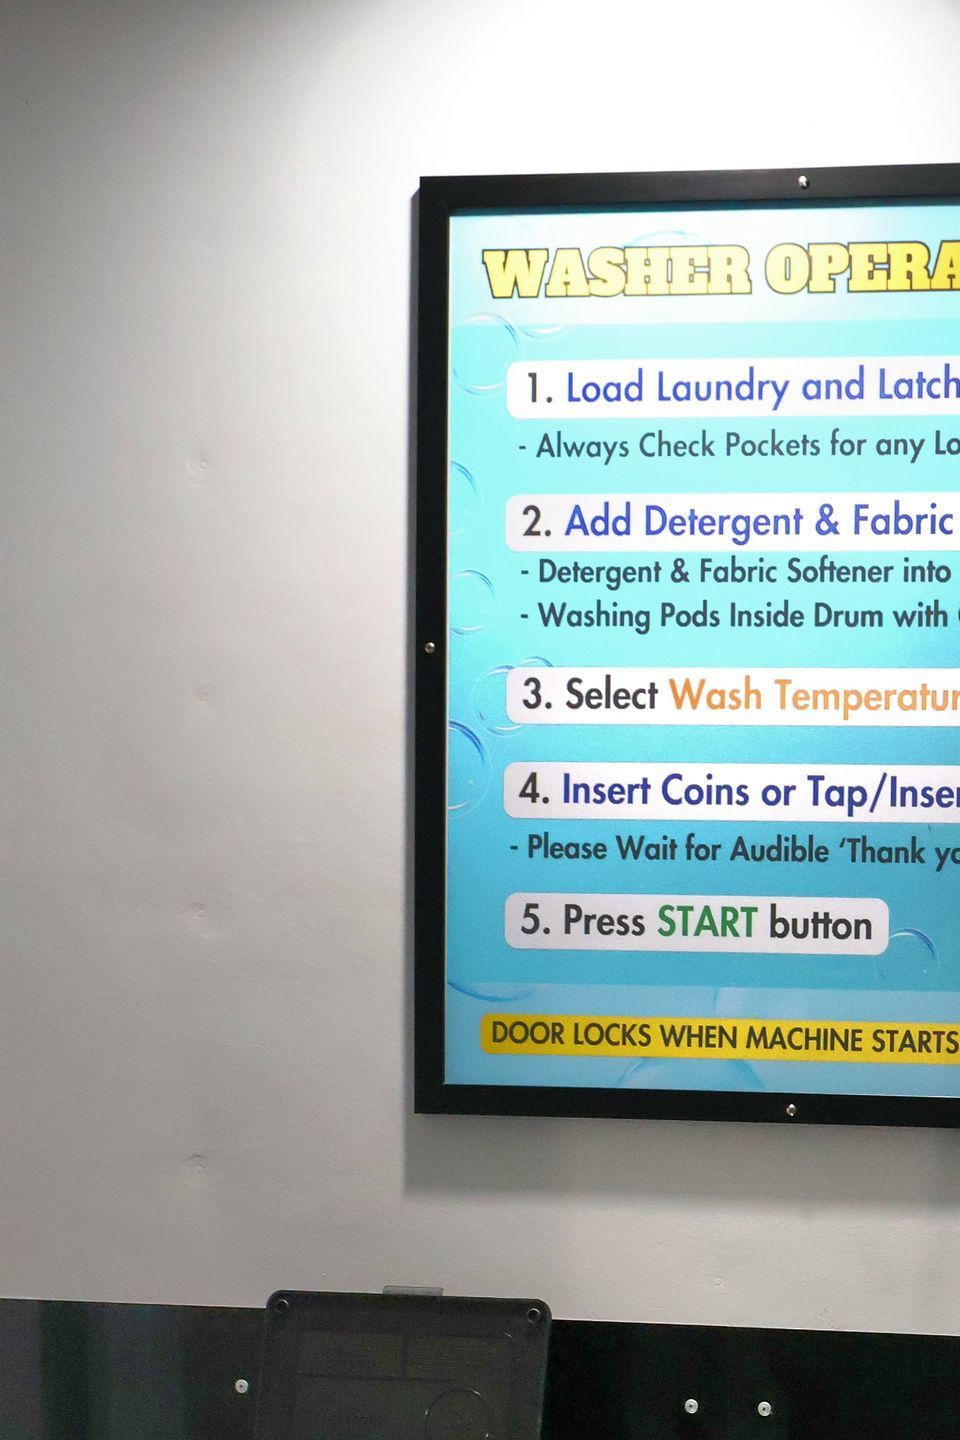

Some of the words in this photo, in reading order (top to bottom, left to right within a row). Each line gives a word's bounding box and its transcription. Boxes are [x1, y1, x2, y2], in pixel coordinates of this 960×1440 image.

[482, 244, 752, 298] WASHER
[528, 372, 552, 404] 1.
[568, 369, 642, 402] Load
[658, 368, 790, 410] Laundry
[803, 365, 864, 401] and
[536, 433, 629, 465] Always
[640, 432, 715, 459] Check
[727, 433, 820, 458] Pockets
[831, 430, 866, 457] for
[876, 437, 925, 464] any
[522, 505, 551, 537] 2.
[565, 503, 631, 537] Add
[647, 506, 803, 545] Detergent
[816, 505, 839, 536] &
[855, 503, 953, 536] Fabric
[540, 559, 662, 591] Detergent
[672, 560, 691, 584] &
[701, 557, 777, 584] Fabric
[788, 558, 891, 584] Softener
[903, 557, 952, 583] into
[538, 603, 650, 635] Washing
[661, 601, 721, 628] Pods
[731, 600, 804, 628] Inside
[814, 602, 884, 628] Drum
[894, 599, 948, 628] with
[522, 679, 552, 709] 3.
[566, 676, 658, 709] Select
[669, 676, 762, 710] Wash
[519, 773, 549, 804] 4.
[563, 774, 651, 806] Insert
[662, 774, 749, 807] Coins
[762, 783, 796, 807] or
[528, 835, 607, 860] Please
[616, 836, 678, 861] Wait
[685, 834, 721, 861] for
[731, 836, 829, 863] Audible
[522, 904, 550, 935] 5.
[564, 904, 645, 937] Press
[658, 905, 758, 938] START
[770, 907, 872, 940] button
[491, 1021, 564, 1045] DOOR
[574, 1023, 651, 1047] LOCKS
[661, 1025, 738, 1050] WHEN
[746, 1026, 863, 1052] MACHINE
[872, 1029, 960, 1054] STARTS
